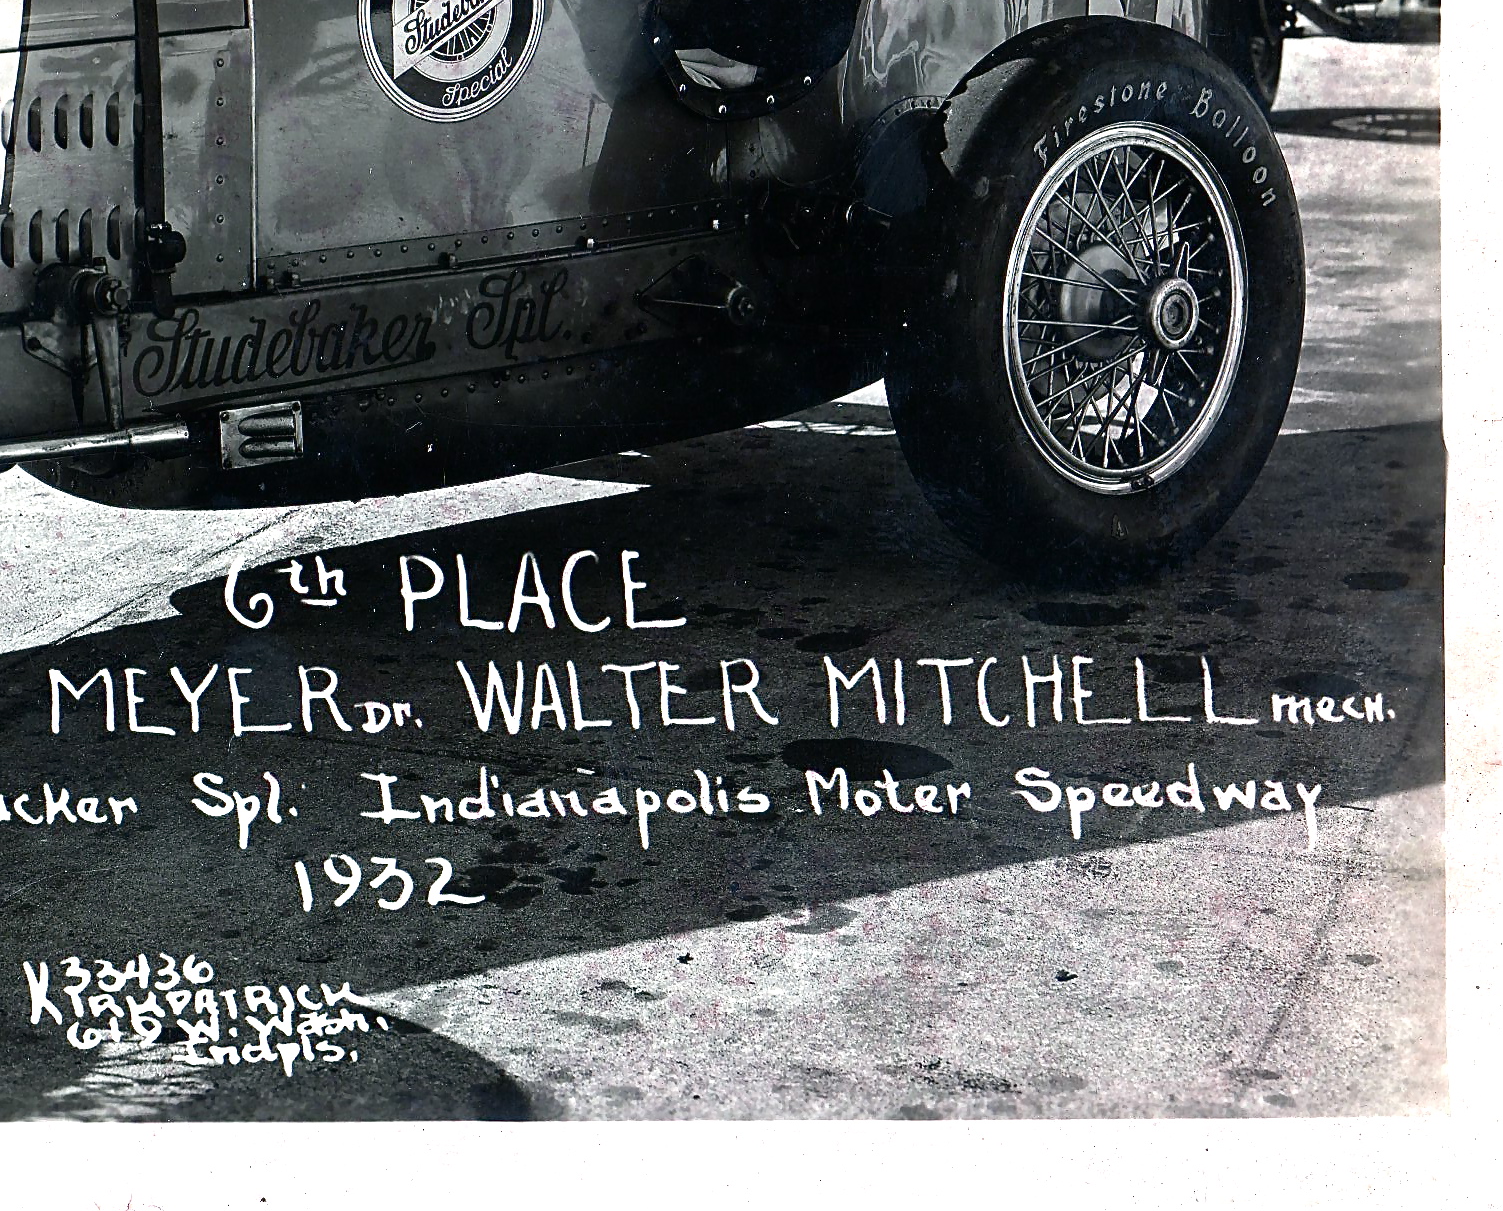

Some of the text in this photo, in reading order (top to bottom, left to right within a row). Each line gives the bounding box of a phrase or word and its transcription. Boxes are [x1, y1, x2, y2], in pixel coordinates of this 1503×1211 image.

[441, 46, 514, 107] Special
[1032, 78, 1278, 208] Firestone Balloon
[132, 265, 572, 397] Studebaker Spl.
